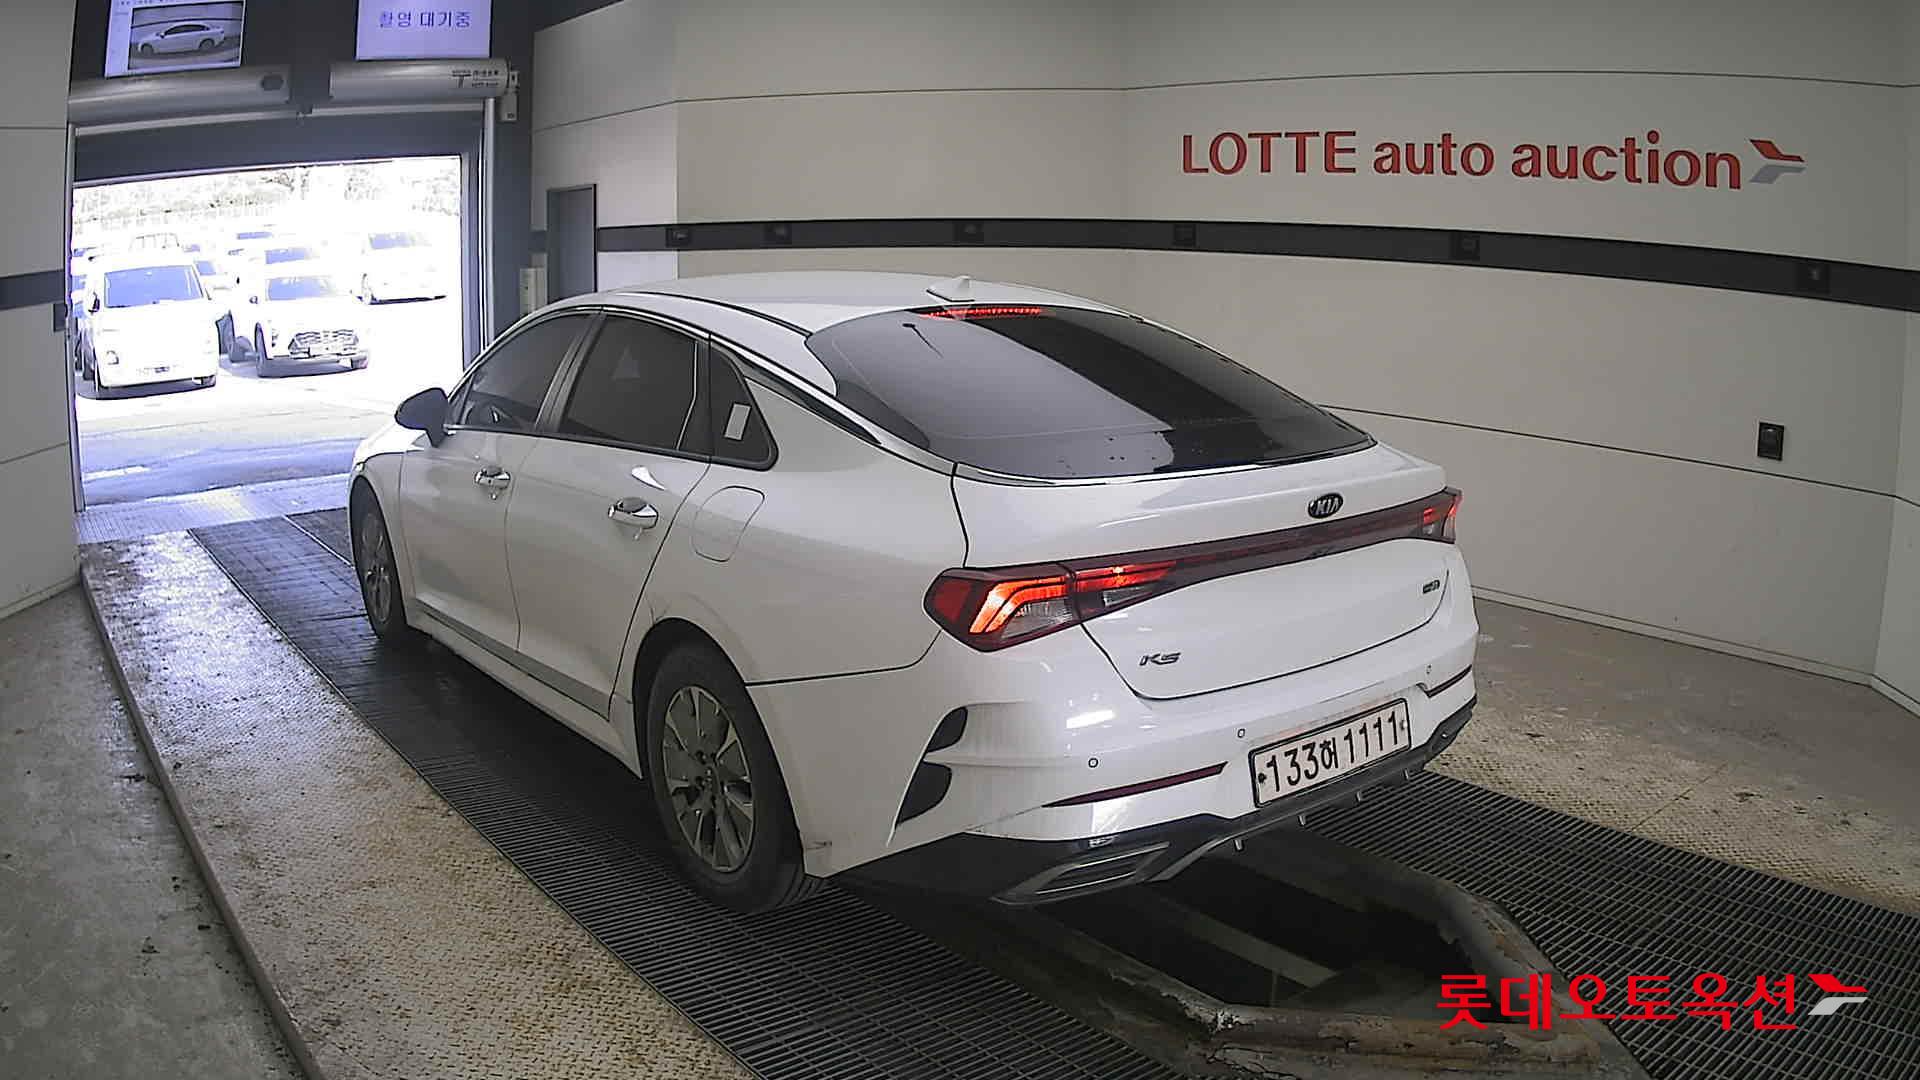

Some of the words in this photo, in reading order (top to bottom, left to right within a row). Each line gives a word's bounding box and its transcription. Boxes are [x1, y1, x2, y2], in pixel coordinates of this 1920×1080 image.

[420, 11, 470, 28] 대기중
[1182, 131, 1356, 175] LOTTE
[1373, 133, 1495, 177] auto
[1511, 130, 1741, 190] auction
[1312, 496, 1341, 516] KIA
[1139, 652, 1181, 666] K5
